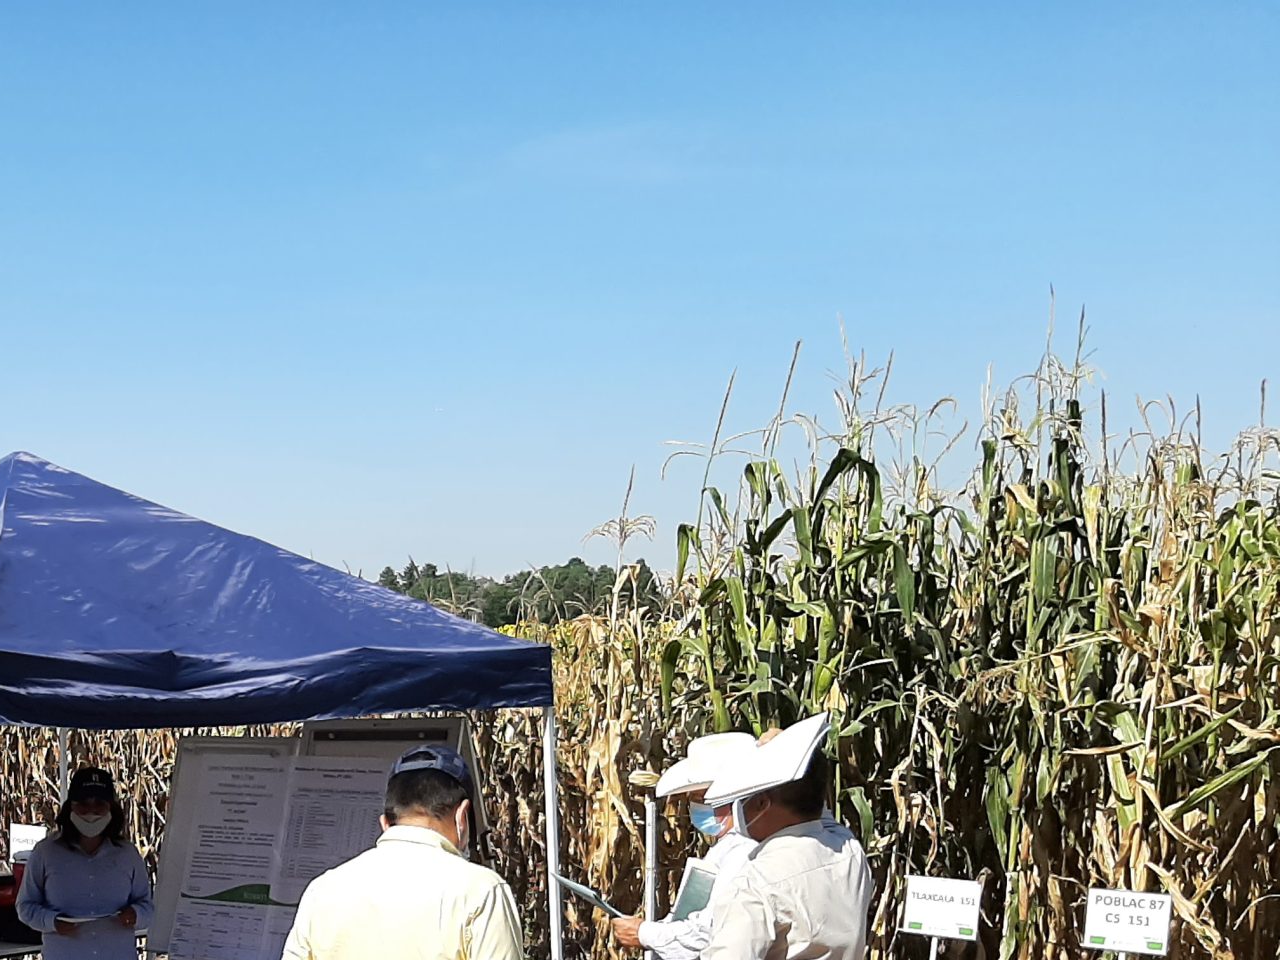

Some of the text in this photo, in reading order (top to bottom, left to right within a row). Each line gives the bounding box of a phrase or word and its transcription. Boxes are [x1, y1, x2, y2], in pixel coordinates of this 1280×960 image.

[960, 896, 976, 906] 151
[1095, 895, 1165, 910] POBLAC 87
[1105, 912, 1150, 927] CS 151
